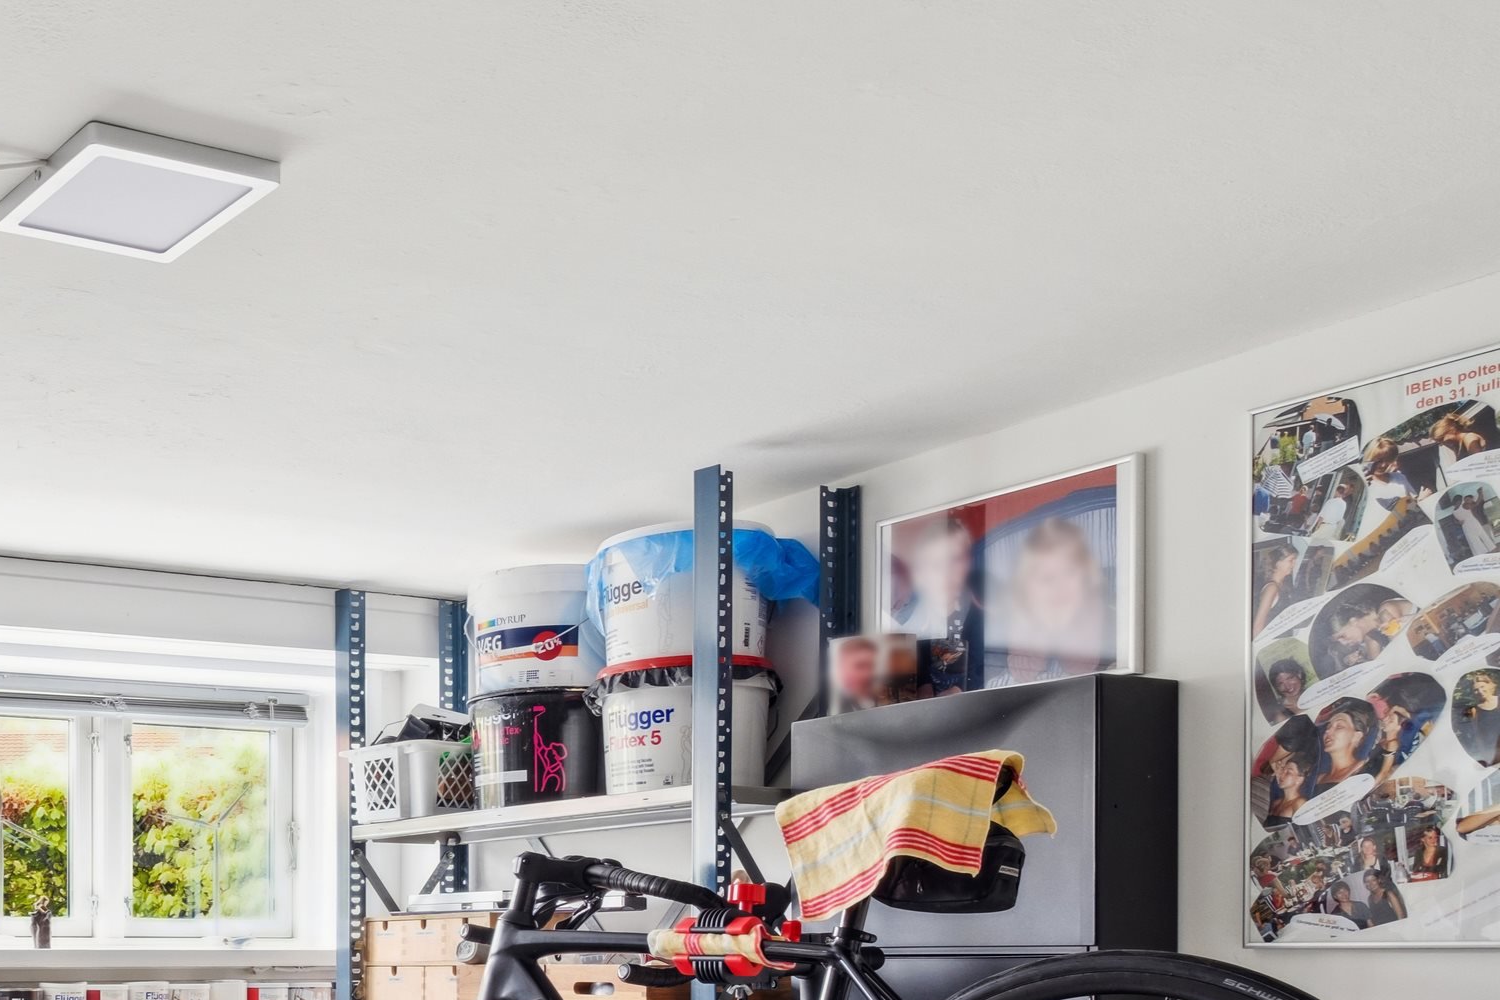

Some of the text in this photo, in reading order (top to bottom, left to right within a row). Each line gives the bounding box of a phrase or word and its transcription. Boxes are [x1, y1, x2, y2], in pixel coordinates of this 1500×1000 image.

[1406, 363, 1500, 396] IBENs polte
[1416, 377, 1500, 409] den 31. juli
[604, 580, 643, 604] ügge
[496, 614, 527, 626] DYRUP
[477, 634, 502, 654] VÆG
[608, 707, 675, 731] Flügger
[650, 730, 662, 745] 5
